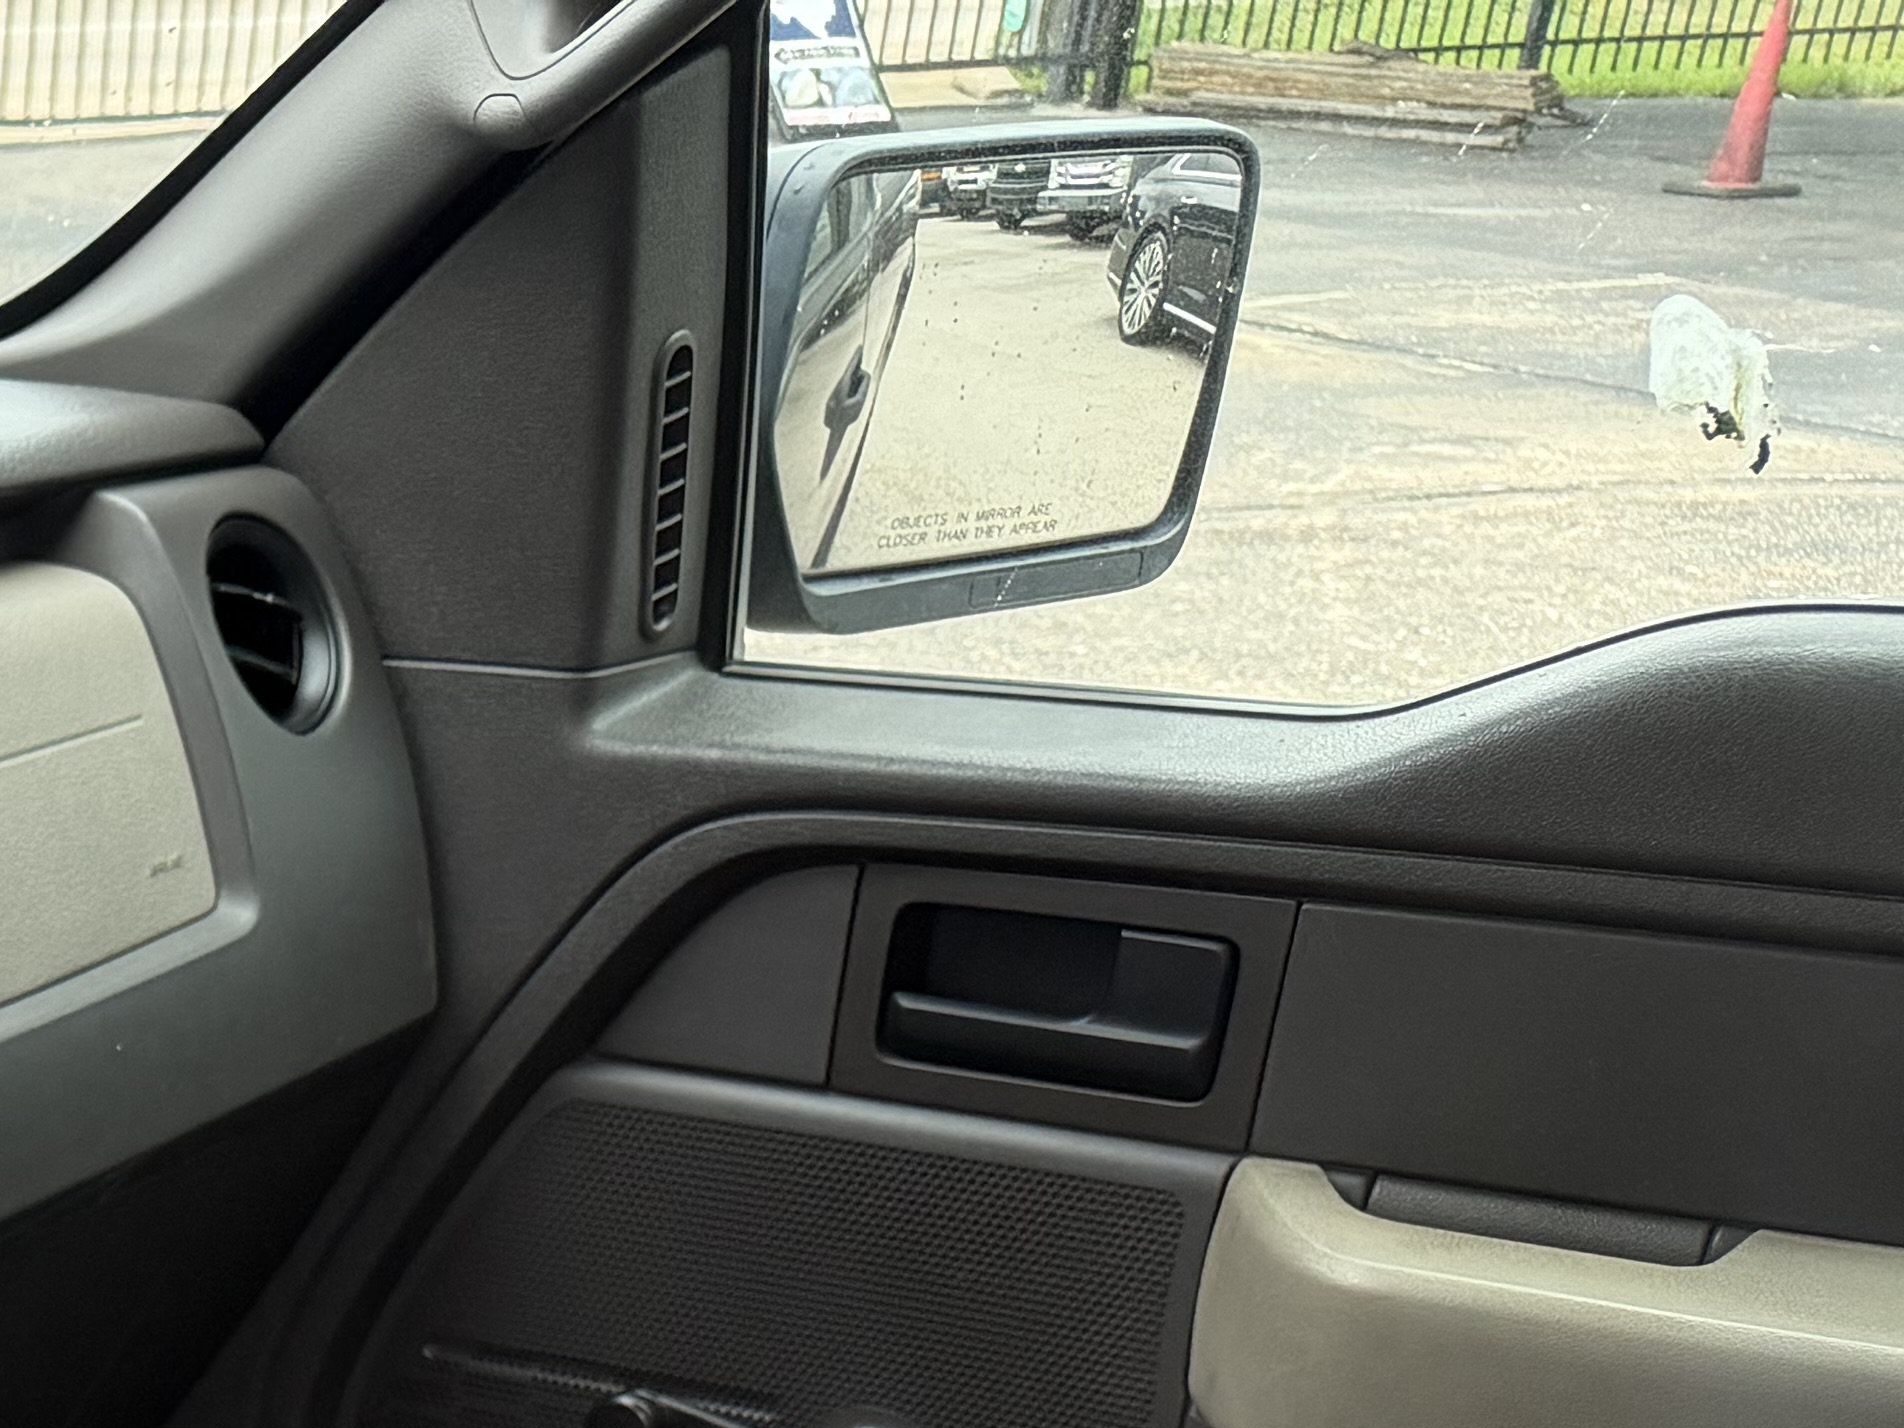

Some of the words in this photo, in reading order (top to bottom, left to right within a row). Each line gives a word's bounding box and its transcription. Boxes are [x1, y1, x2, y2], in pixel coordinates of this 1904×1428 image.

[892, 512, 948, 531] OBJECTS
[956, 511, 970, 523] IN
[975, 506, 1022, 521] MIRROR
[1027, 503, 1052, 516] ARE
[877, 531, 928, 549] CLOSER
[935, 529, 968, 543] THAN
[974, 524, 1004, 539] THEY
[1009, 519, 1058, 536] APPEAR
